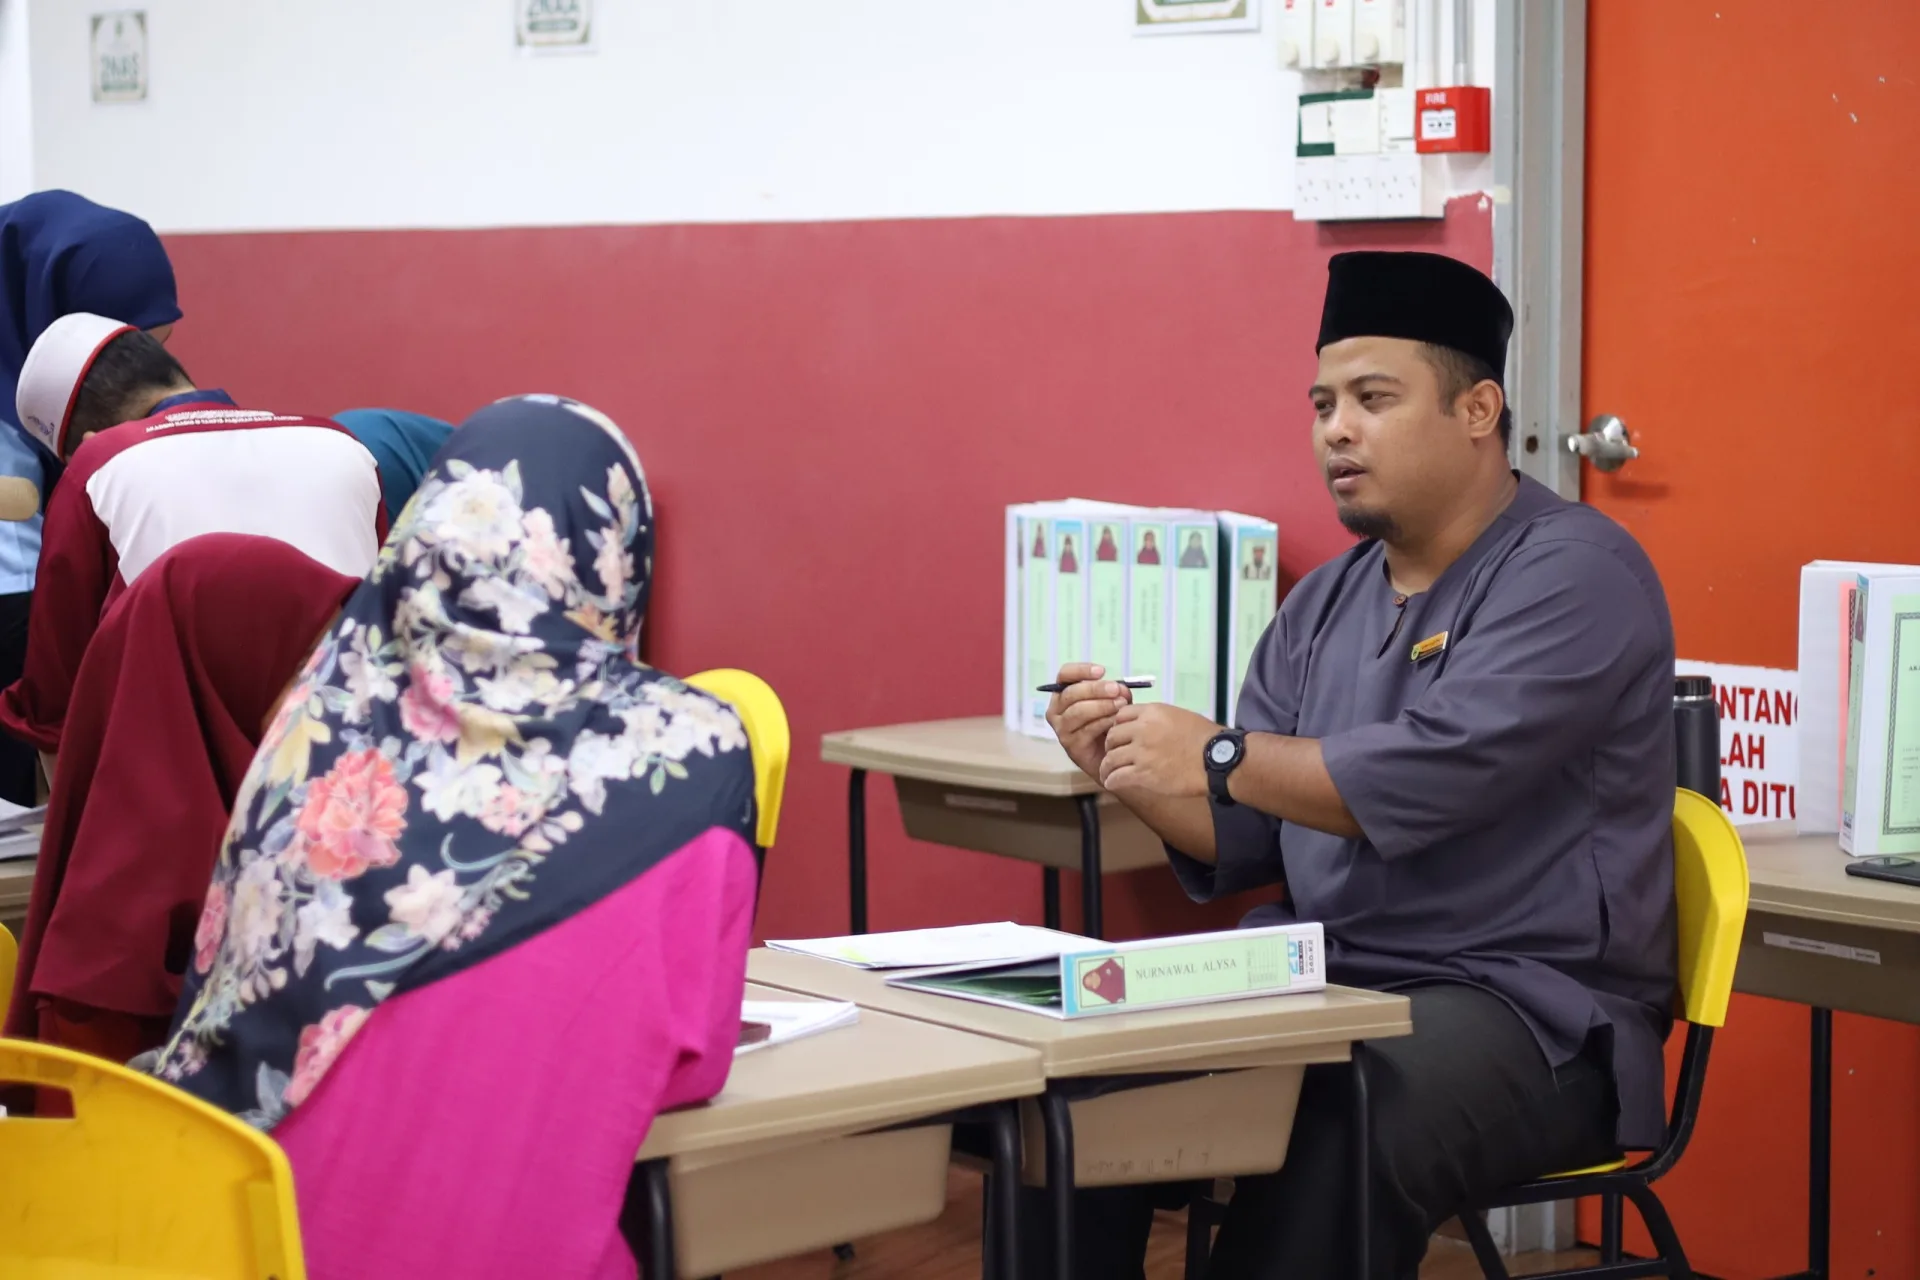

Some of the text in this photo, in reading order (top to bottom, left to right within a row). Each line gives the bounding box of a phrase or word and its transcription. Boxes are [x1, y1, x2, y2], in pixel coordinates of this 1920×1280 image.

[1425, 92, 1447, 104] FIRE
[1711, 684, 1798, 727] NTAN
[1135, 963, 1197, 981] NURNAWAL
[1203, 958, 1237, 973] ALYSA
